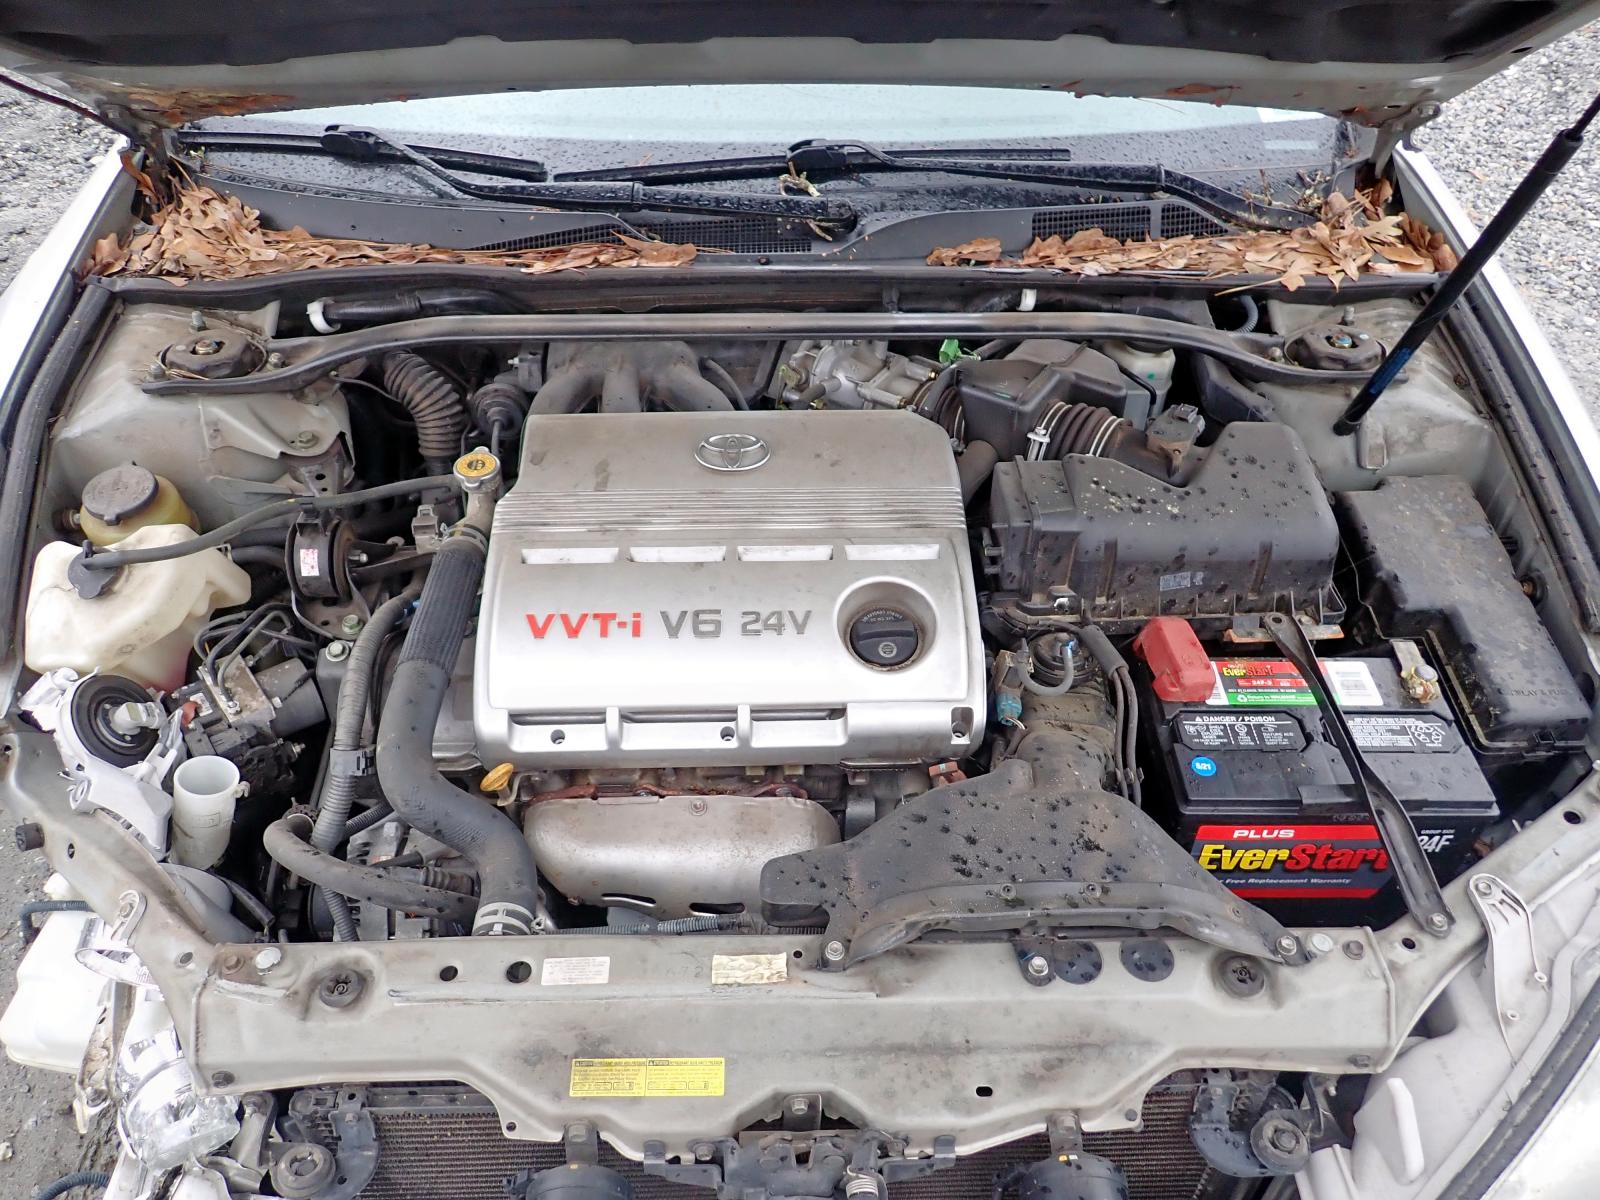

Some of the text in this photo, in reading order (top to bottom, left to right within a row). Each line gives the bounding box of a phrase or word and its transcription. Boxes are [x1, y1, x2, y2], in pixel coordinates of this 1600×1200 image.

[526, 609, 812, 639] VVT-i V6 24V
[1233, 829, 1296, 838] PLUS
